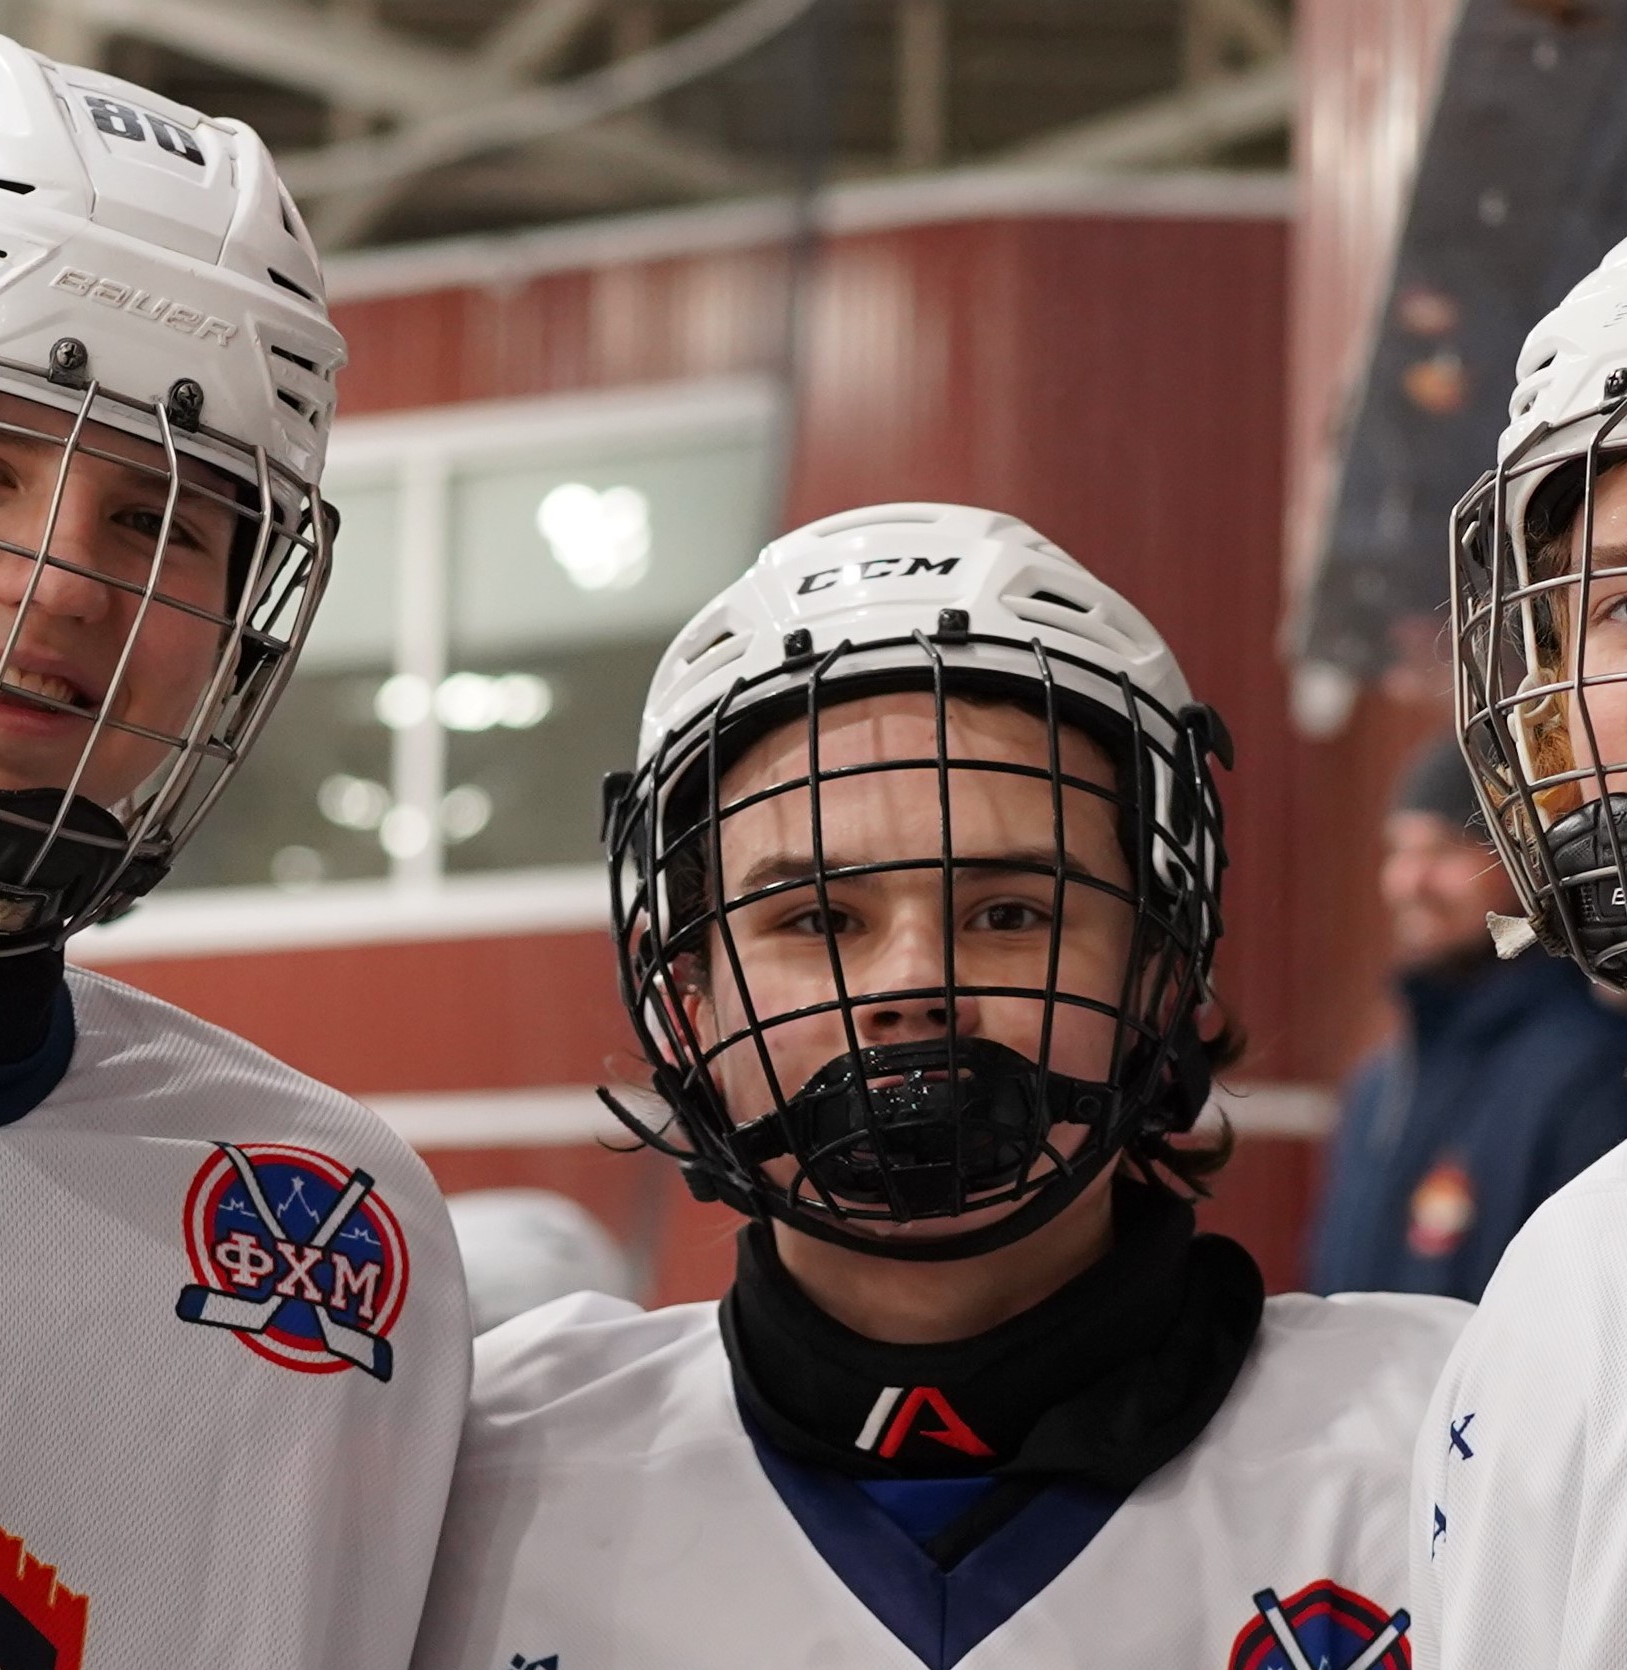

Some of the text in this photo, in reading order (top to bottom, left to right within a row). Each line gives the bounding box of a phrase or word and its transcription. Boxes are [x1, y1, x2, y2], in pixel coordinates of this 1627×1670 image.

[82, 94, 207, 167] 80
[48, 264, 241, 348] BAUER
[797, 556, 963, 596] CCM
